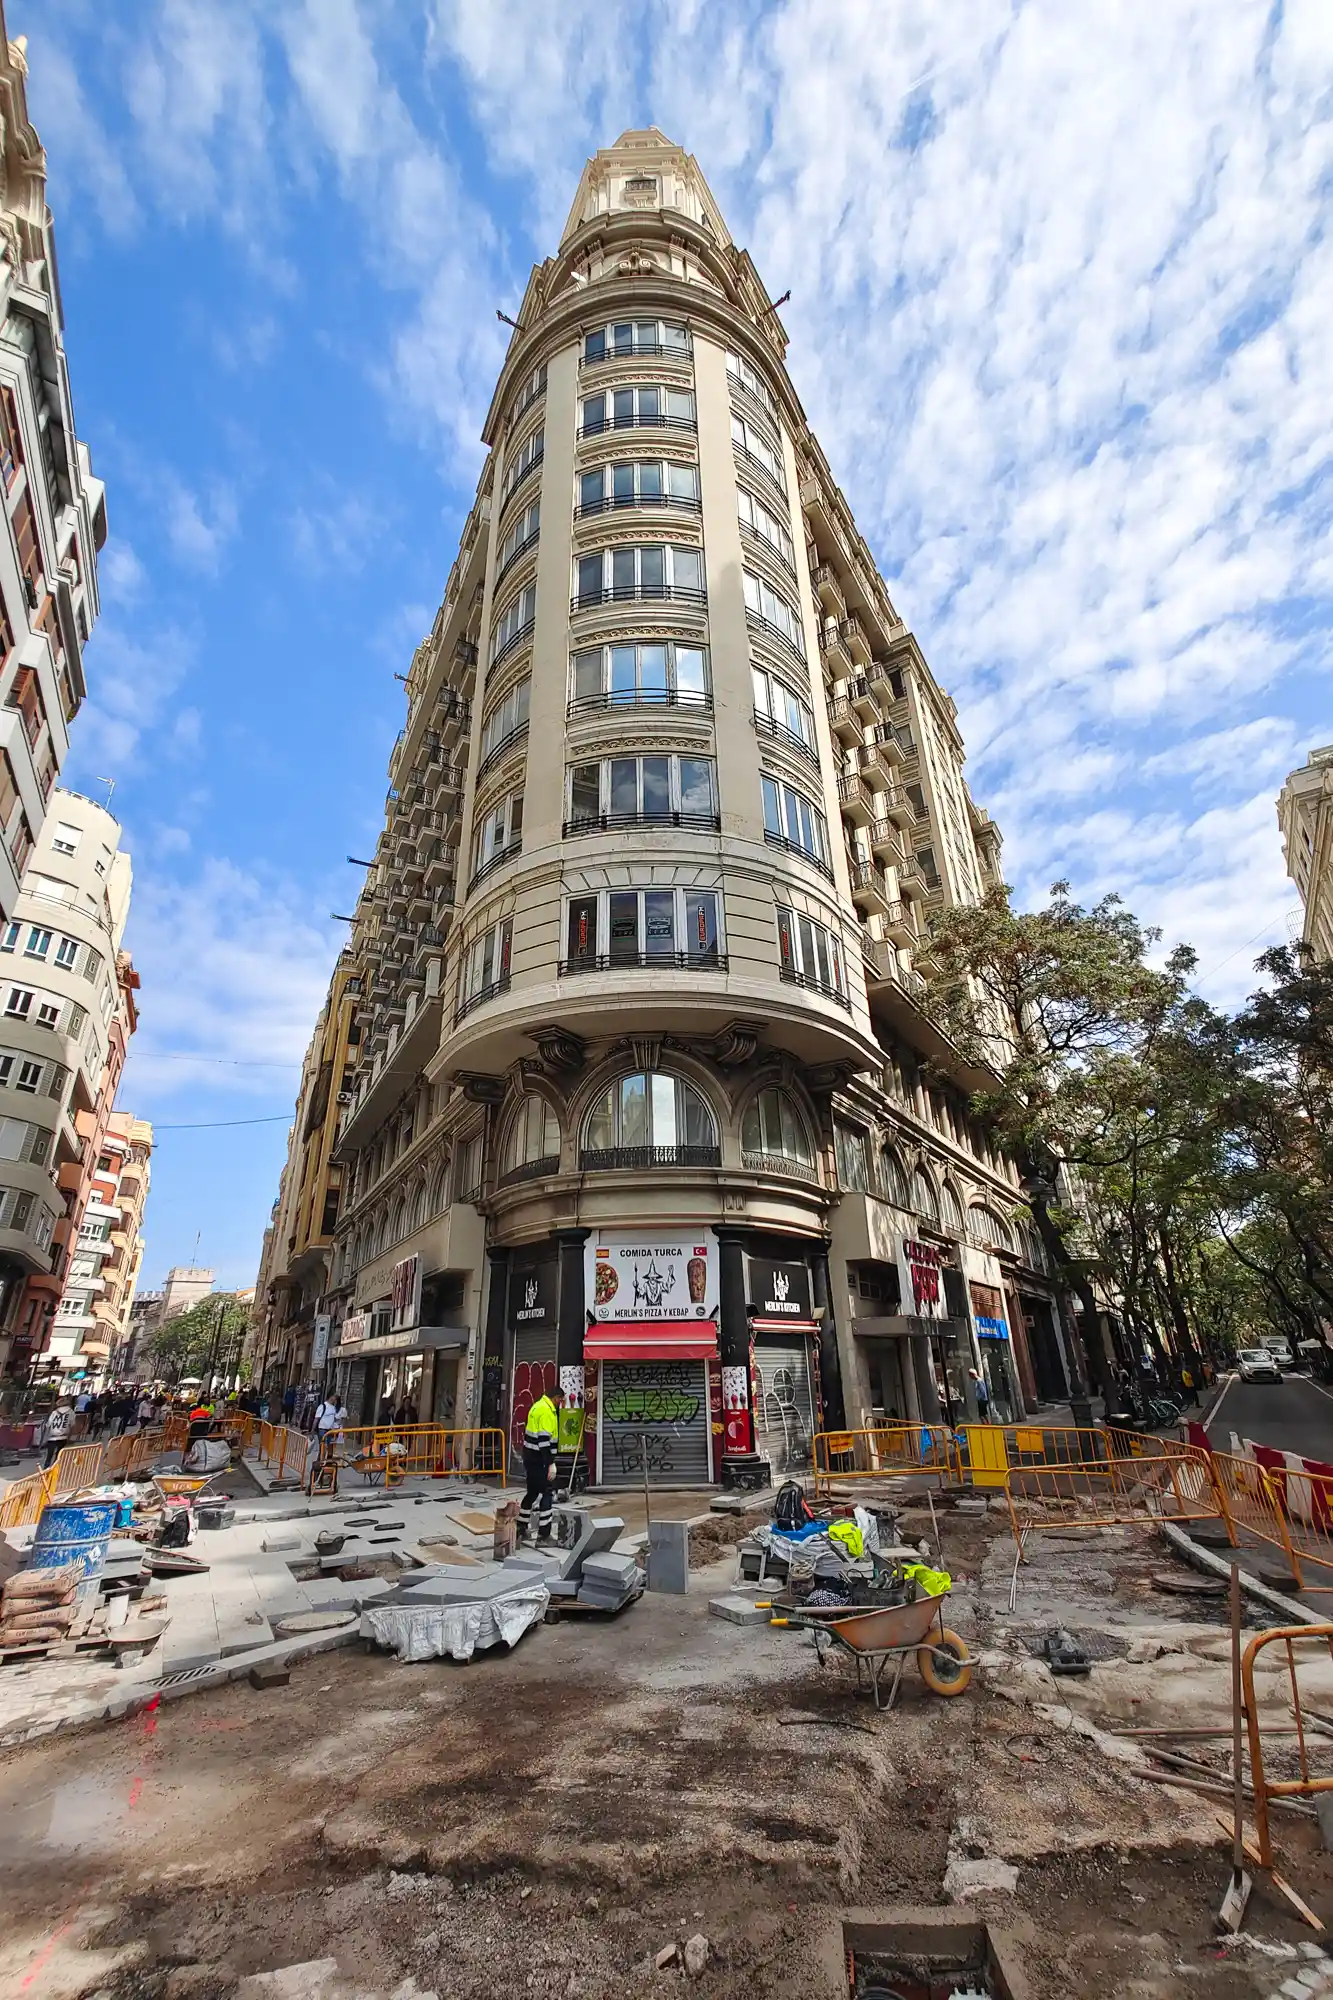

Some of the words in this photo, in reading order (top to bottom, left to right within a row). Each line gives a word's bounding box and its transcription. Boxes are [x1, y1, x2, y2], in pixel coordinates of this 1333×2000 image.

[620, 1249, 652, 1257] COMIDA
[654, 1248, 683, 1257] TURCA
[614, 1309, 644, 1318] MERLIN'S
[644, 1308, 661, 1317] PIZZA
[663, 1308, 668, 1317] Y
[668, 1307, 689, 1316] KEBAP
[53, 1413, 70, 1421] ME
